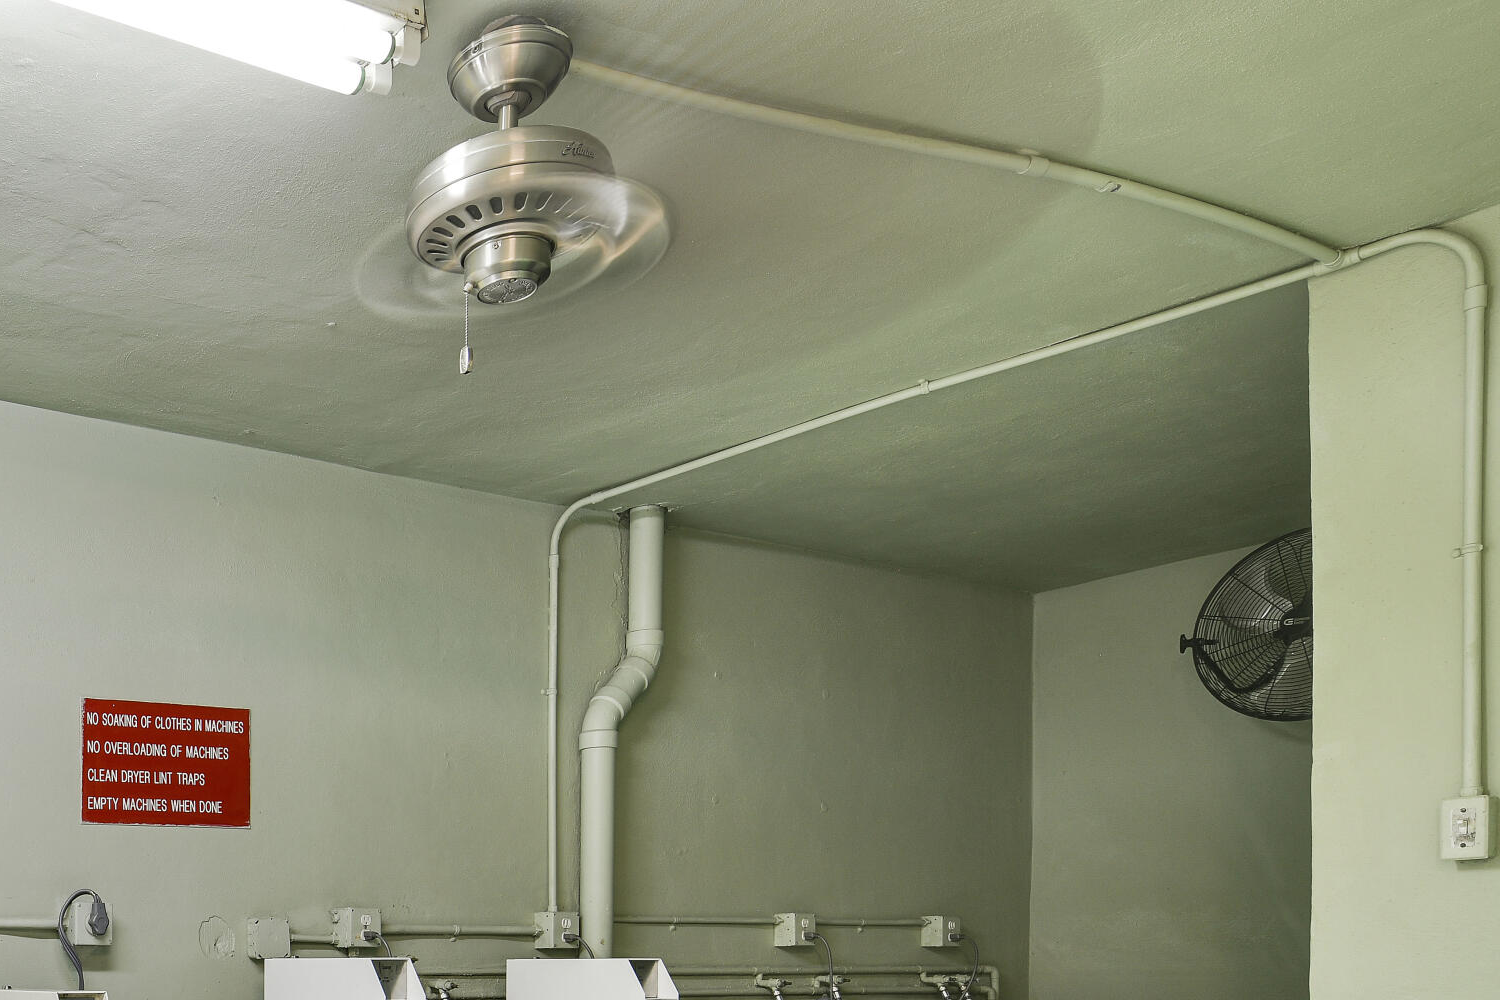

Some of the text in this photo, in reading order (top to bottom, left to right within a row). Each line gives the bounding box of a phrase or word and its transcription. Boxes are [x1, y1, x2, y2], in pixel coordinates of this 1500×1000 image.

[87, 712, 243, 733] NO SOAKING OF CLOTHES IN MACHINES
[87, 741, 229, 760] NO OVERLOADING OF MACHINES
[88, 769, 205, 786] CLEAN DRYER LINT TRAPS
[88, 797, 222, 813] EMPTY MACHINES WHEN DONE
